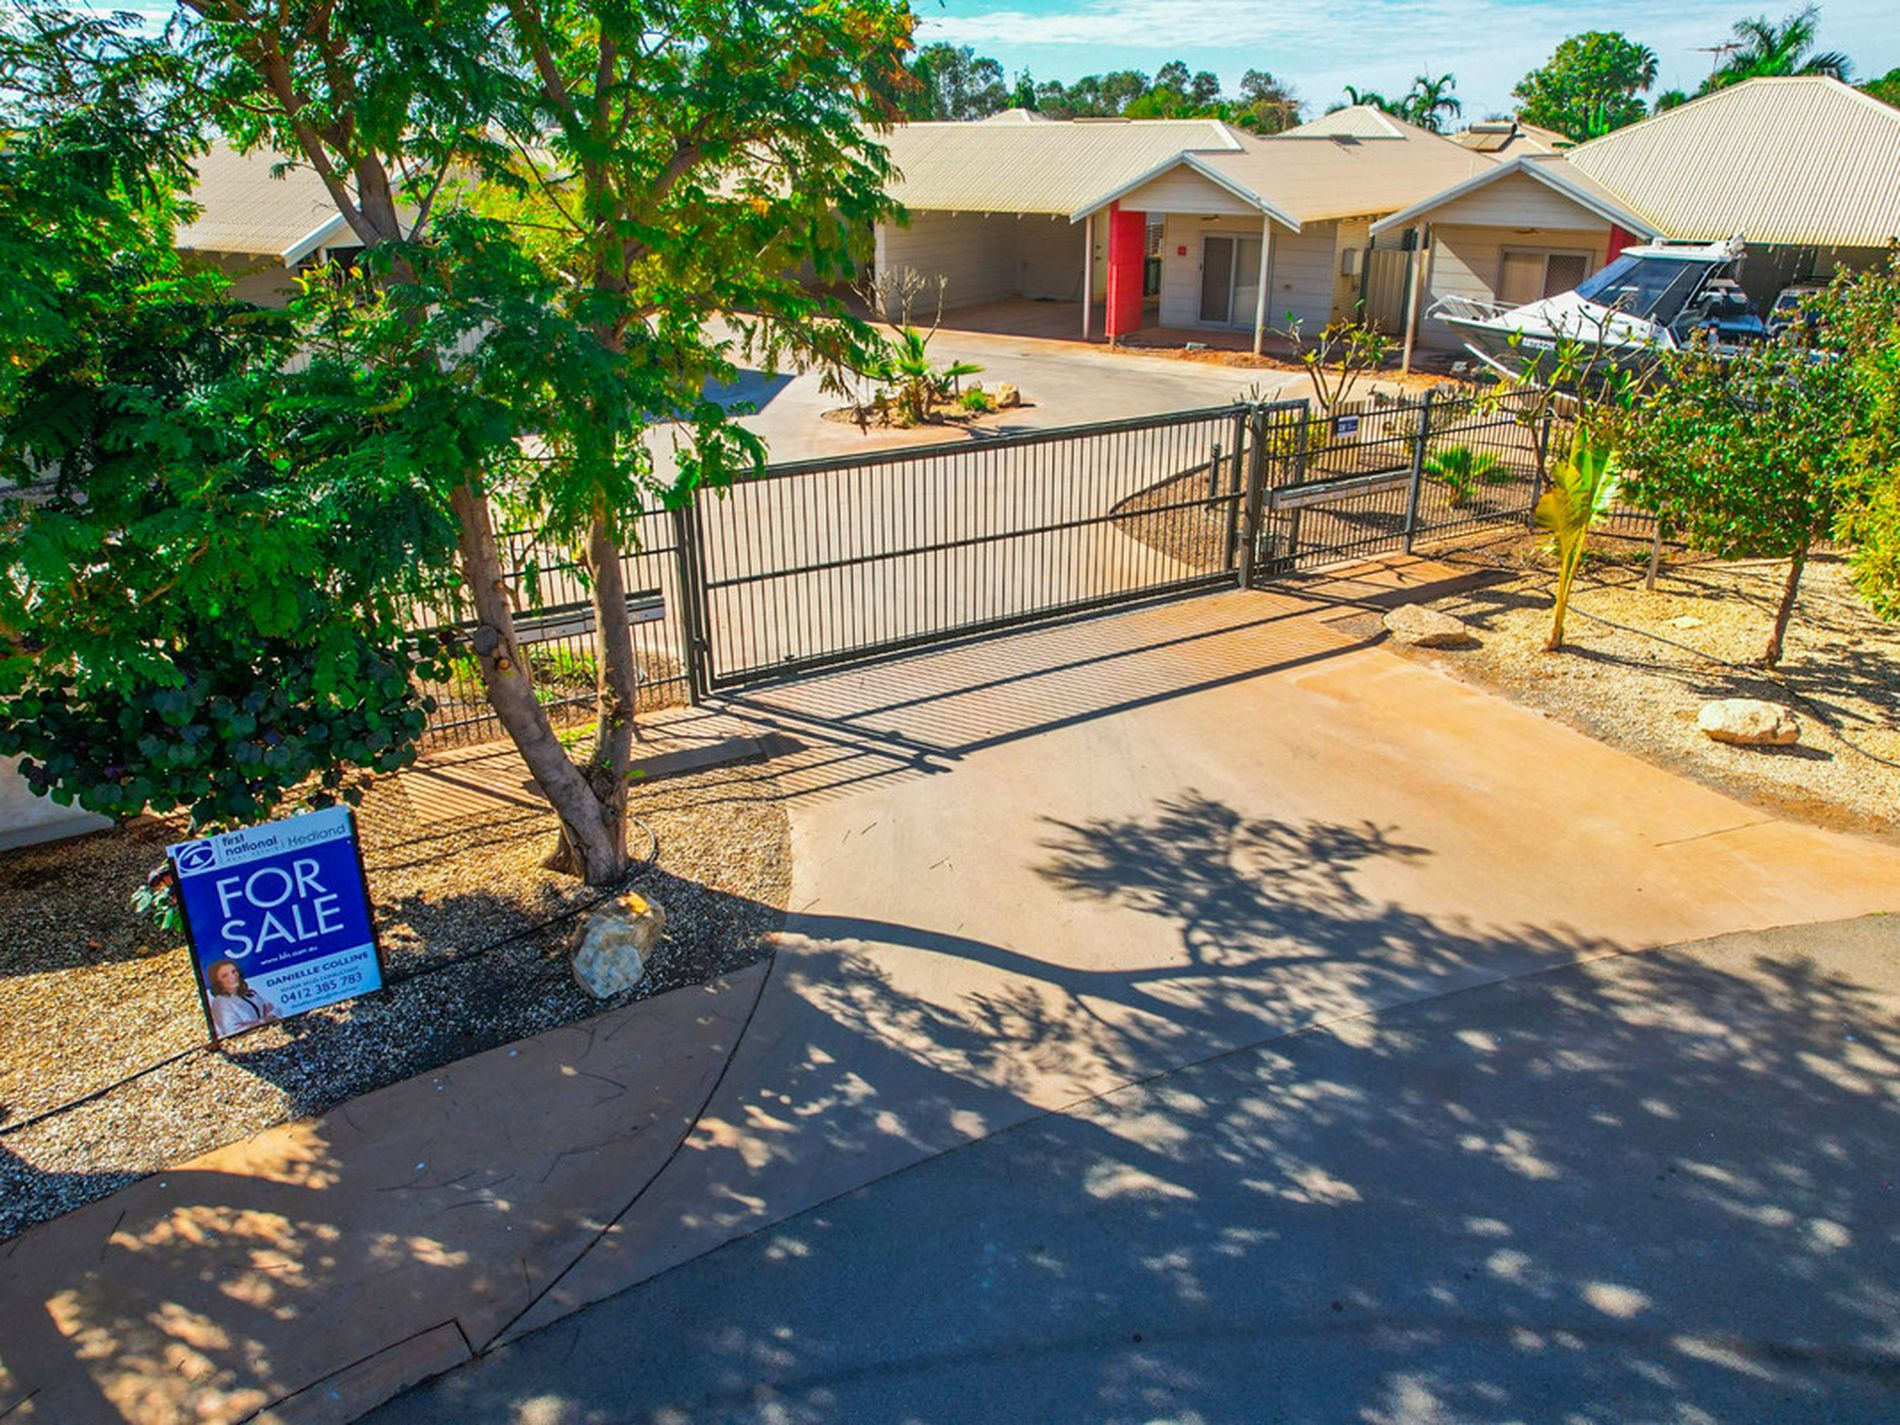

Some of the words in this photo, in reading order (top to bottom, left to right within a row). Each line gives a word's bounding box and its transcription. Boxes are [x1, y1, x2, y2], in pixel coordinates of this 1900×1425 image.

[222, 834, 245, 846] first
[225, 836, 277, 856] national
[287, 823, 346, 848] Hedland
[216, 858, 327, 918] FOR
[221, 893, 344, 959] SALE
[266, 966, 319, 987] DANIELLE
[322, 951, 368, 970] COLLINS
[280, 988, 312, 1004] 0412
[315, 980, 337, 994] 385
[341, 972, 363, 986] 783
